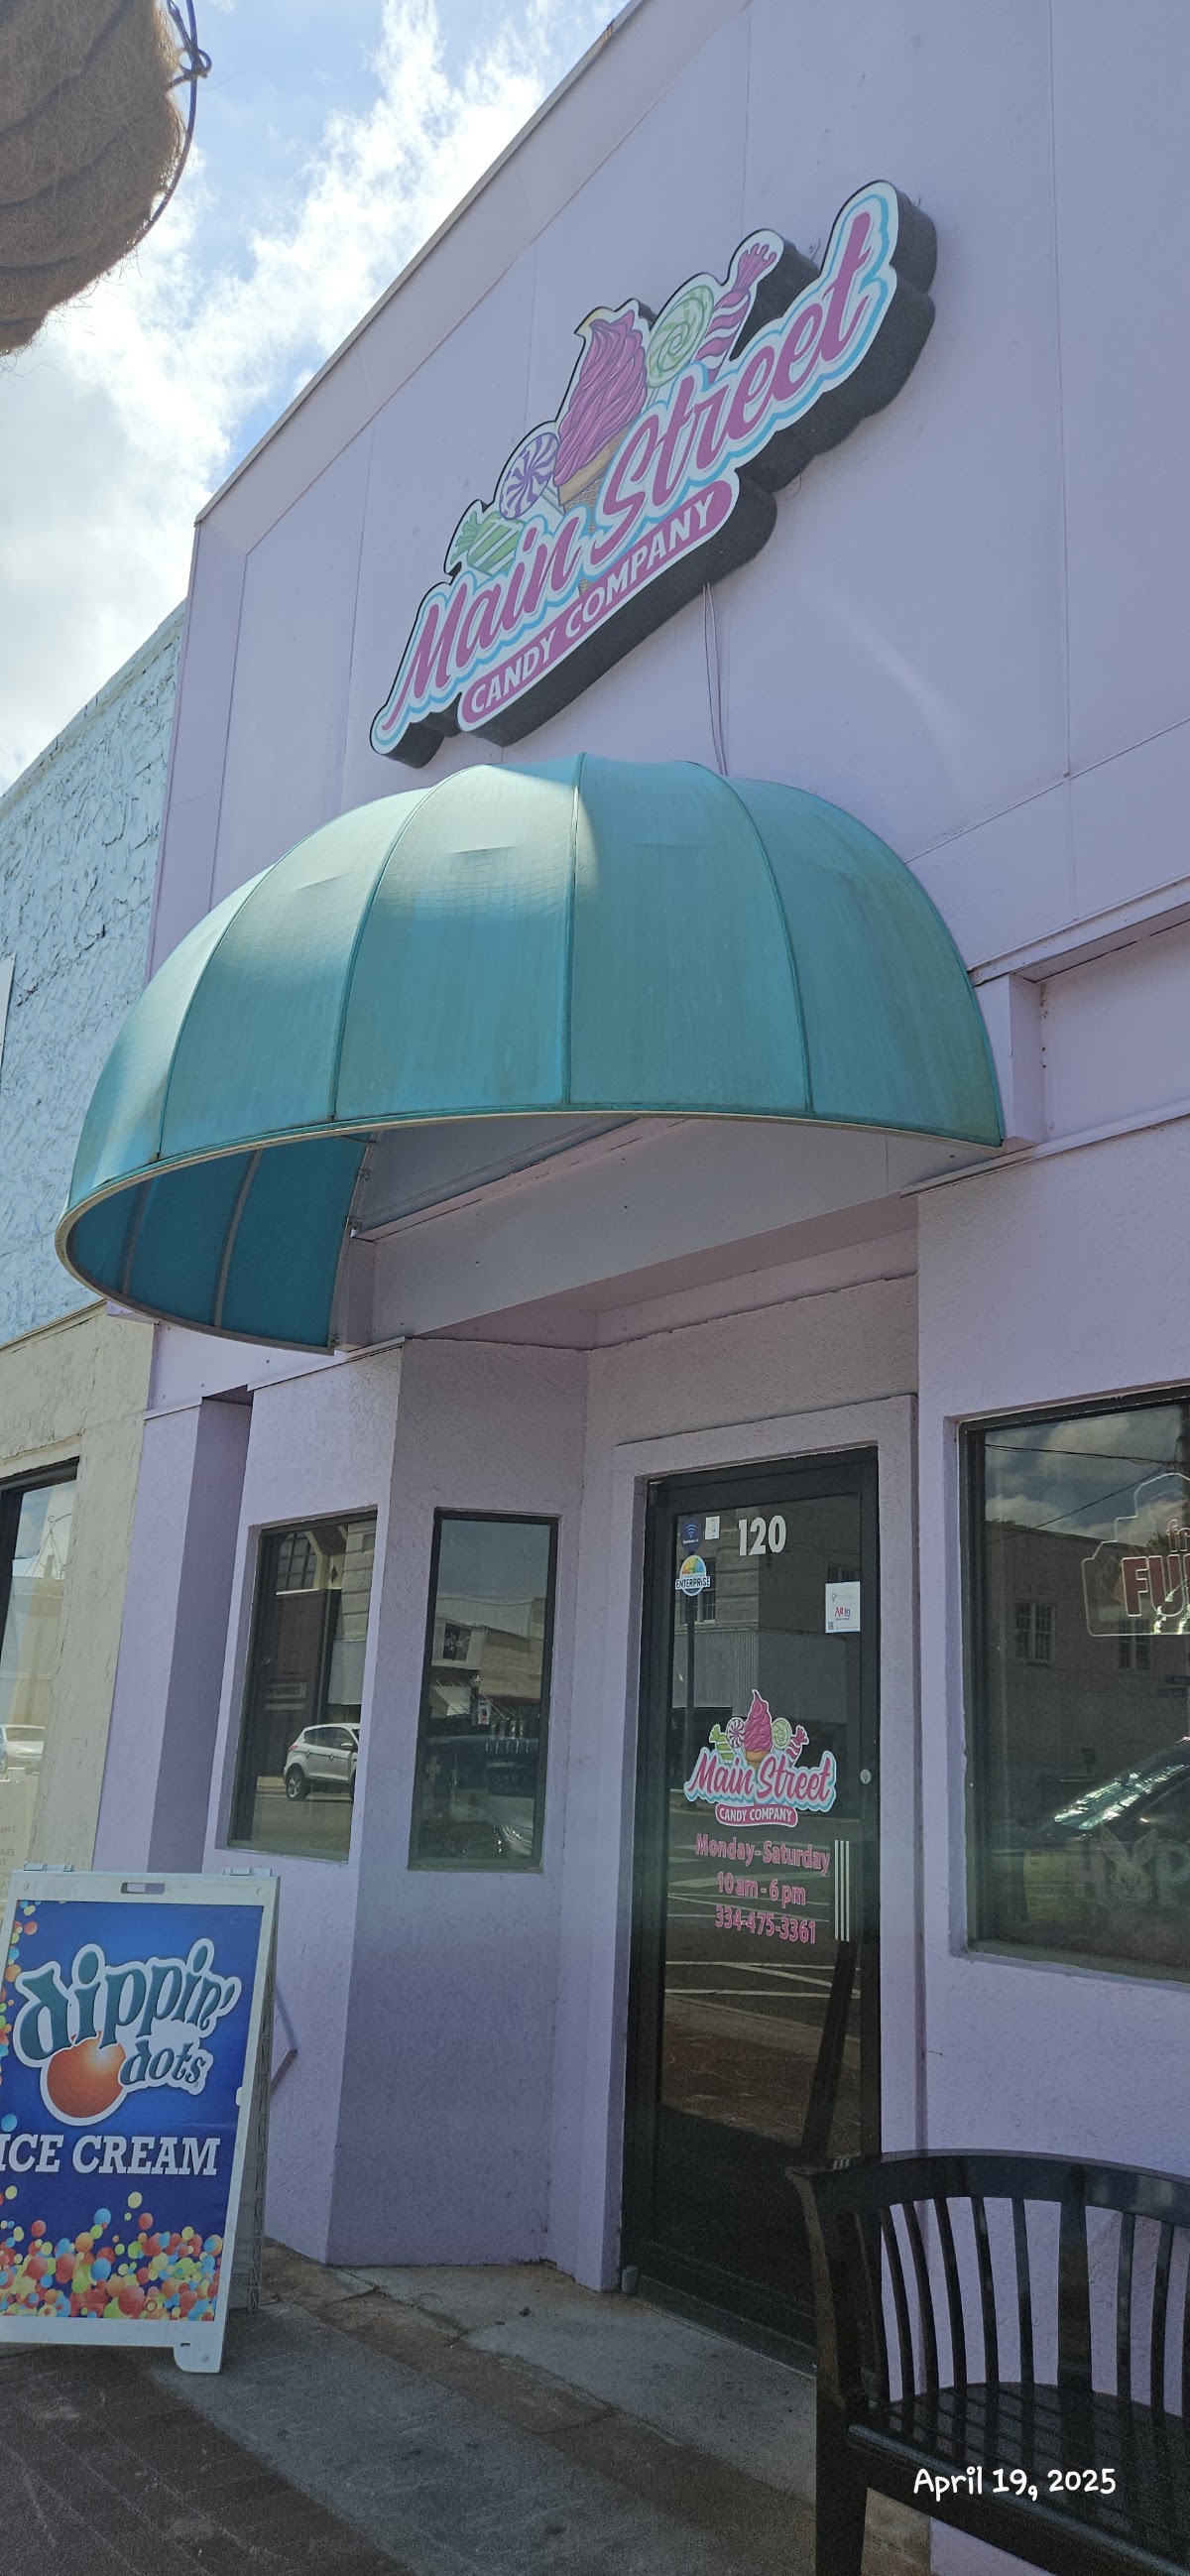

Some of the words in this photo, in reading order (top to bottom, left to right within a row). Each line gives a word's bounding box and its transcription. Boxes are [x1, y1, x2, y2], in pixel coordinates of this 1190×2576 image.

[381, 516, 588, 731] Main
[590, 211, 875, 566] Street
[470, 625, 557, 716] CANDY
[566, 497, 715, 635] COMPANY
[738, 1515, 787, 1557] 120
[675, 1576, 711, 1589] ENTERPRISE
[1122, 1554, 1190, 1617] FU
[688, 1752, 754, 1794] Main
[757, 1755, 831, 1802] Street
[719, 1807, 747, 1823] CANDY
[750, 1807, 792, 1823] COMPANY
[717, 1872, 734, 1895] 10
[736, 1878, 759, 1899] am
[769, 1879, 779, 1901] 6
[781, 1885, 806, 1909] pm
[715, 1904, 816, 1944] 334-475-3361
[119, 2038, 207, 2086] dots
[0, 2134, 64, 2173] ICE
[71, 2135, 221, 2176] CREAM
